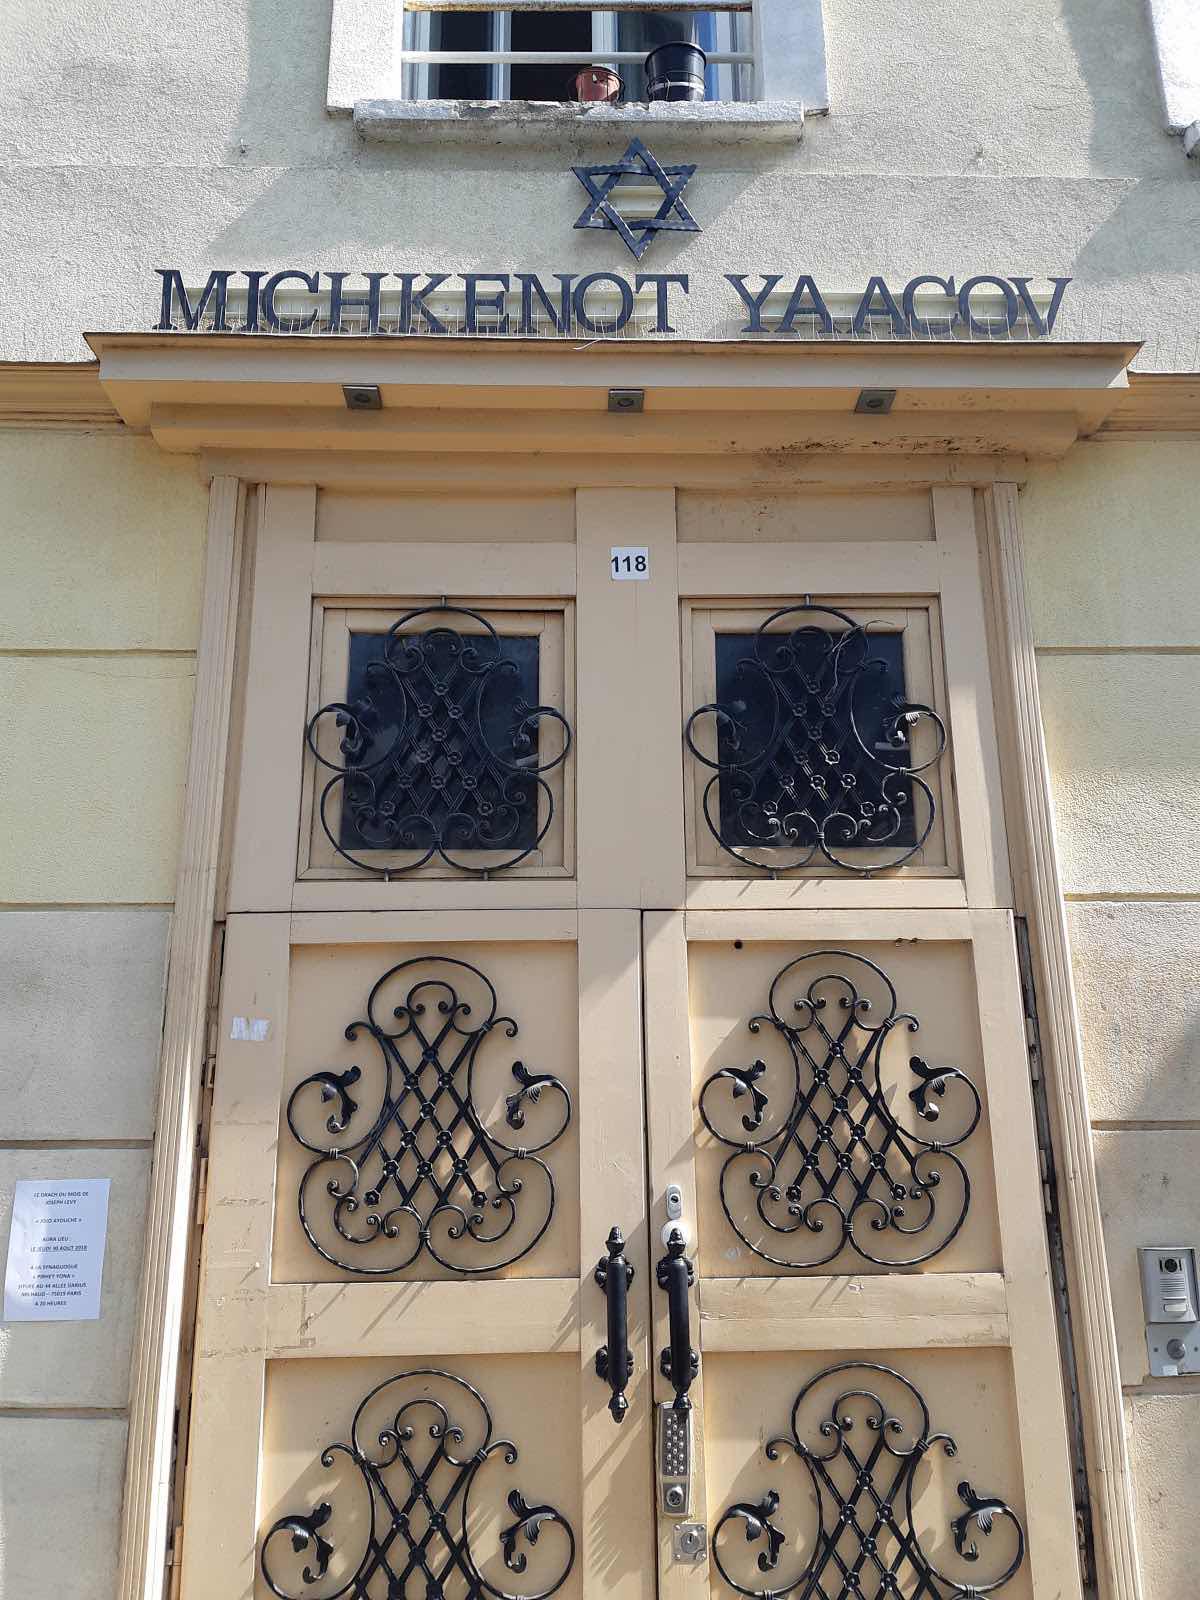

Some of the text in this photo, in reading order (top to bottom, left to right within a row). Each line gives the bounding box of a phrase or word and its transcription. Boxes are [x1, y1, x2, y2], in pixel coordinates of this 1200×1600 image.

[152, 269, 1073, 336] MICHKENOT YAACOV
[611, 555, 647, 573] 118
